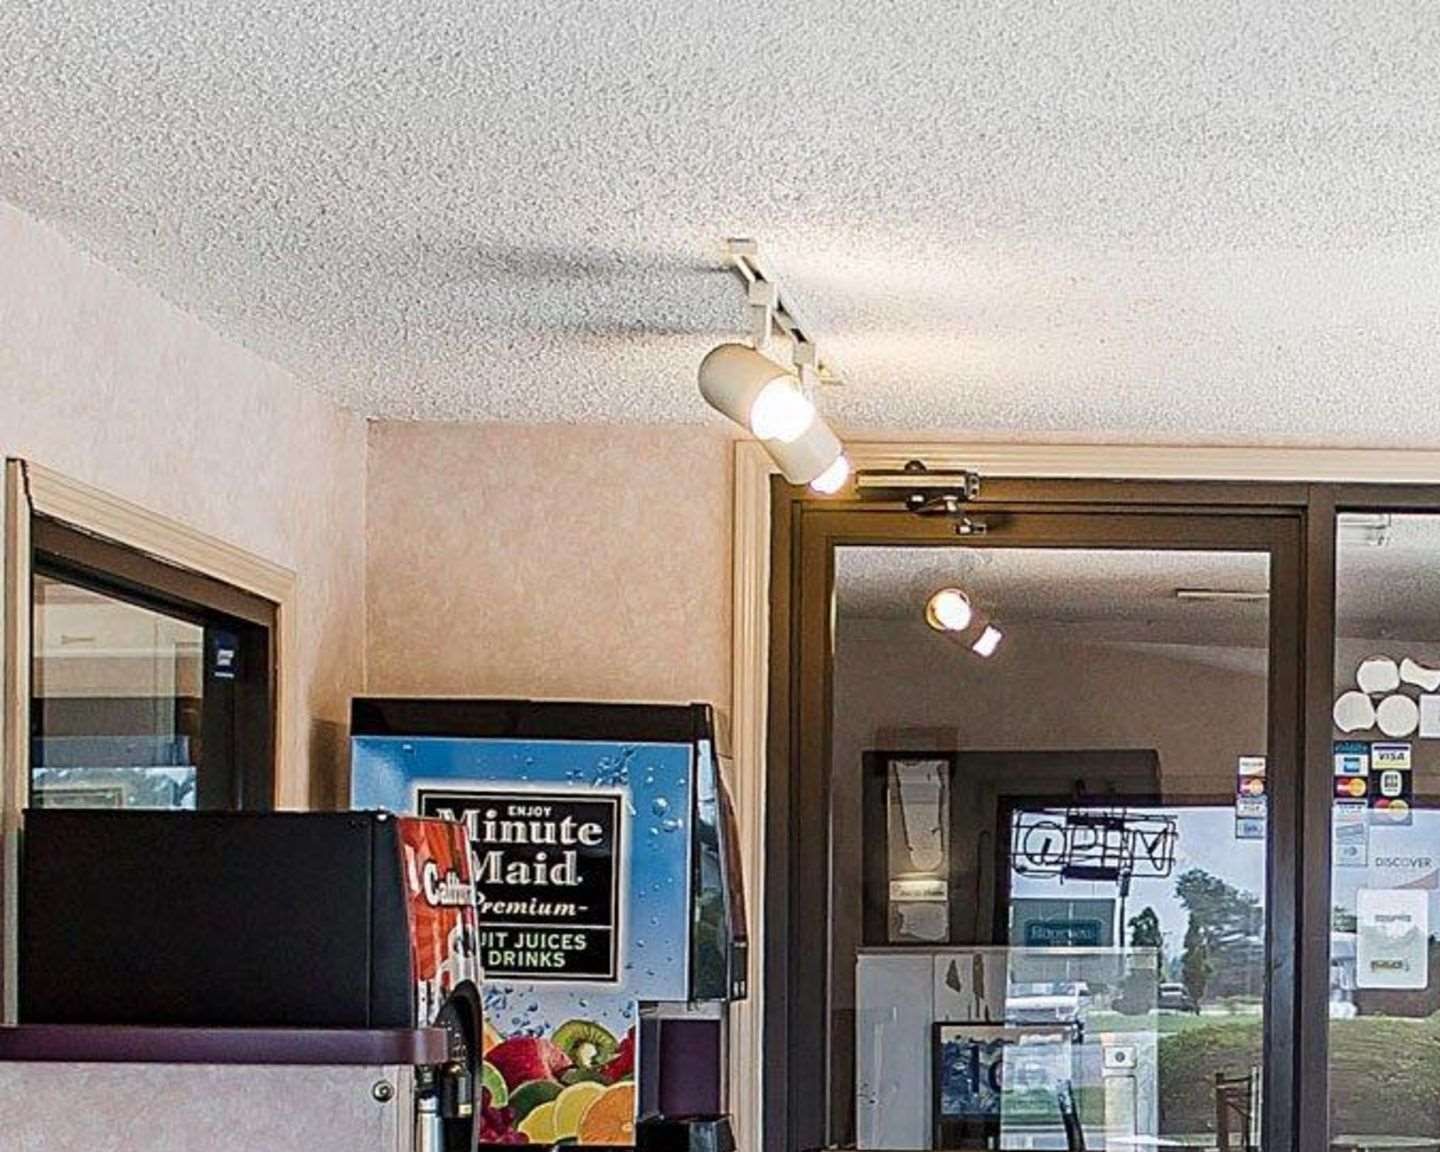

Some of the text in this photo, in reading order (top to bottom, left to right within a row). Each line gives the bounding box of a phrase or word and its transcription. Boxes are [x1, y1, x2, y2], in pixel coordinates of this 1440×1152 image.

[1379, 752, 1405, 761] VISA
[508, 805, 552, 817] ENJOY
[437, 807, 603, 846] Minute
[1375, 857, 1432, 867] DISCOVER
[514, 934, 588, 951] JUICES
[488, 951, 566, 968] DRINKS
